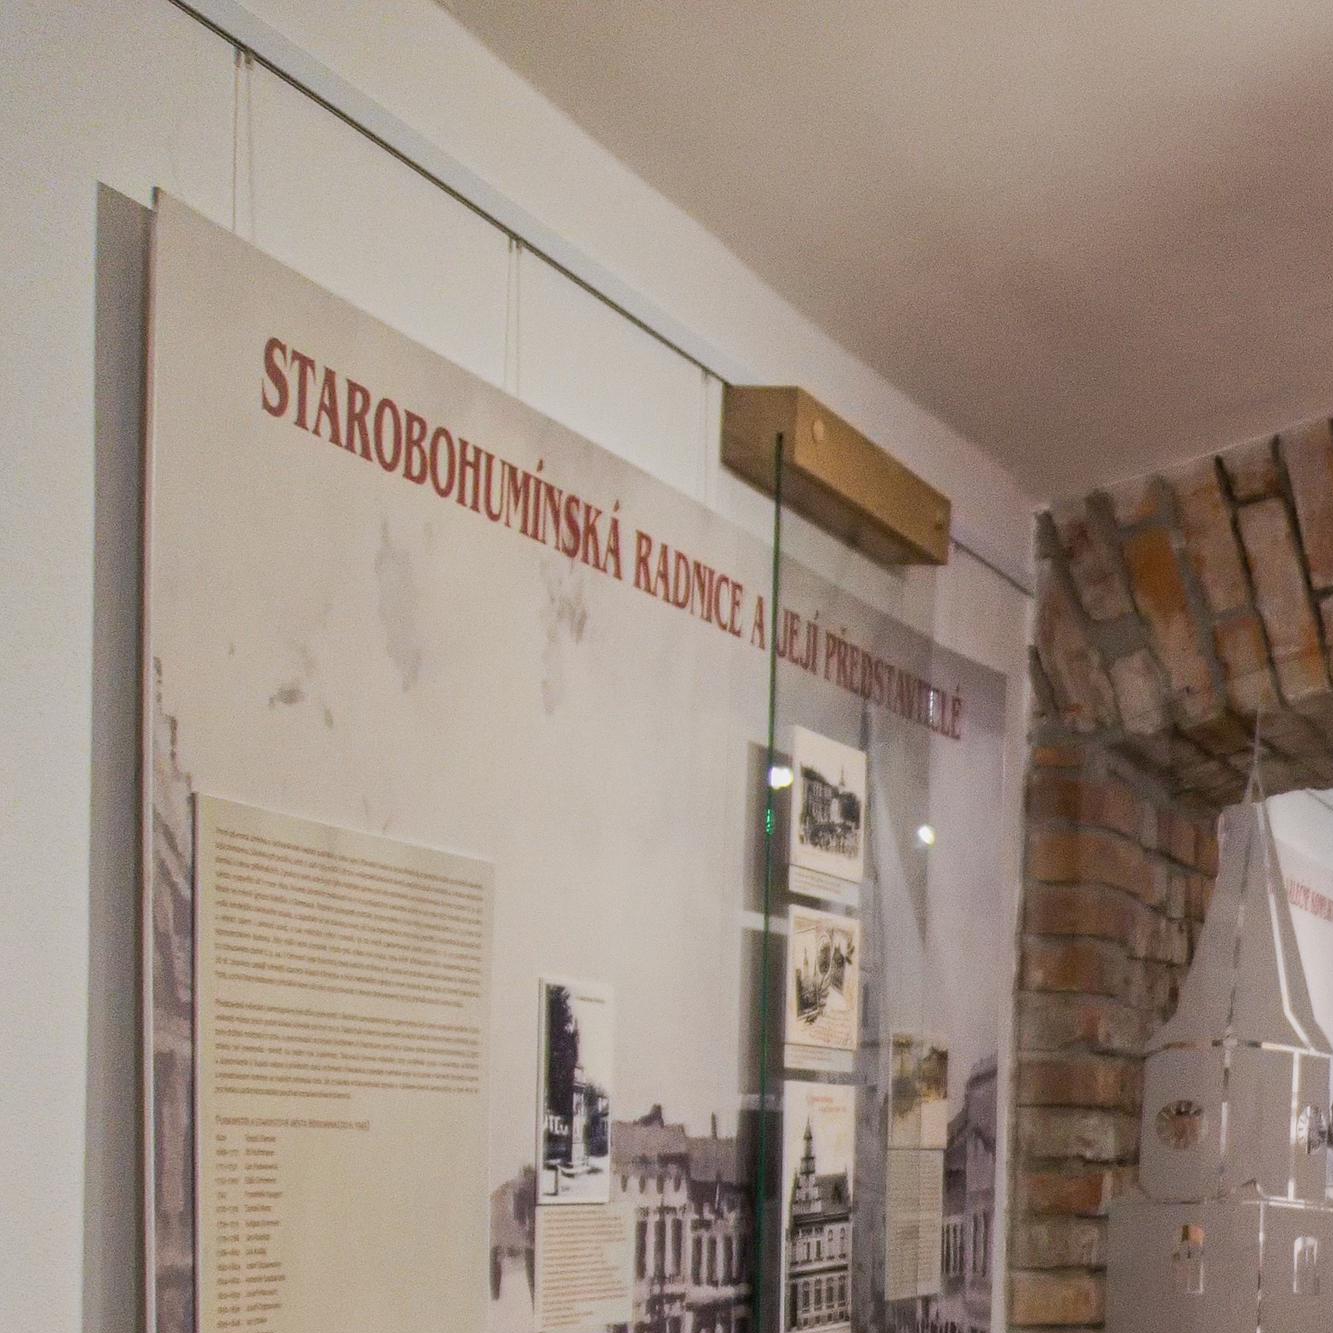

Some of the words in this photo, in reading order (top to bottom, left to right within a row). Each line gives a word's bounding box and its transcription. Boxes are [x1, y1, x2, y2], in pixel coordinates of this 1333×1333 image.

[261, 338, 624, 581] STAROBOHUMÍNSKÁ
[634, 530, 745, 638] RADNICE
[751, 596, 766, 650] A
